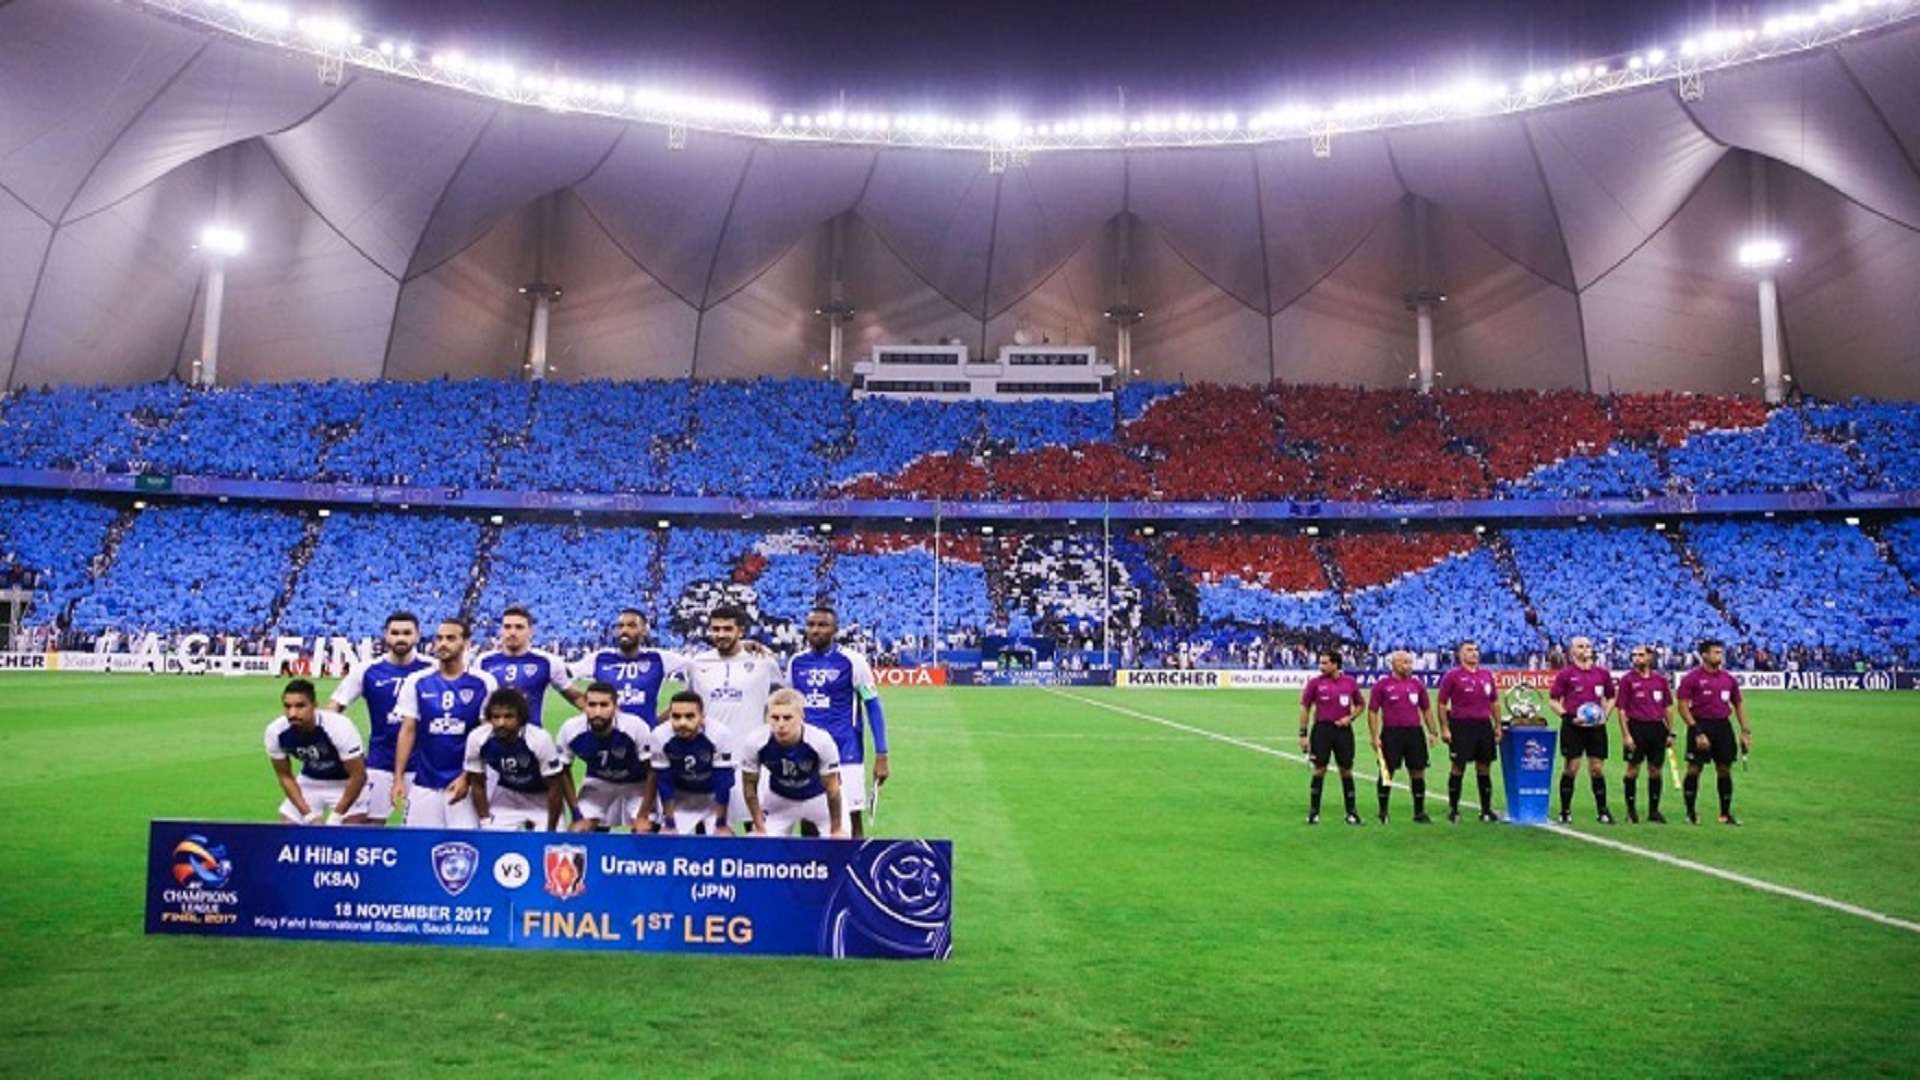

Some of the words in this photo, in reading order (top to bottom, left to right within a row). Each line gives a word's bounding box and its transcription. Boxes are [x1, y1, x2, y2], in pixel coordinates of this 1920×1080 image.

[504, 666, 517, 681] 3
[616, 661, 638, 681] 70
[806, 669, 826, 687] 33
[872, 668, 933, 684] YOTA
[1749, 674, 1781, 687] QNB
[1788, 671, 1859, 689] Allianz
[391, 677, 402, 697] 7
[442, 690, 455, 711] 8
[597, 750, 609, 768] 7
[278, 844, 299, 862] Al
[304, 845, 350, 864] Hilal
[355, 848, 397, 867] SFC
[601, 855, 666, 876] Urawa
[673, 857, 714, 877] Red
[721, 859, 829, 880] Diamonds
[313, 871, 360, 889] (KSA)
[162, 890, 238, 905] CHAMPIONS
[691, 882, 736, 902] (JPN)
[181, 903, 219, 913] LEAGUE
[335, 901, 352, 917] 18
[356, 903, 450, 921] NOVEMBER
[456, 906, 492, 922] 2017
[254, 915, 278, 930] King
[280, 916, 306, 929] Fahd
[309, 917, 372, 932] International
[422, 922, 452, 934] Saudi
[454, 923, 490, 935] Arabia
[523, 910, 621, 940] FINAL
[684, 915, 754, 943] LEG
